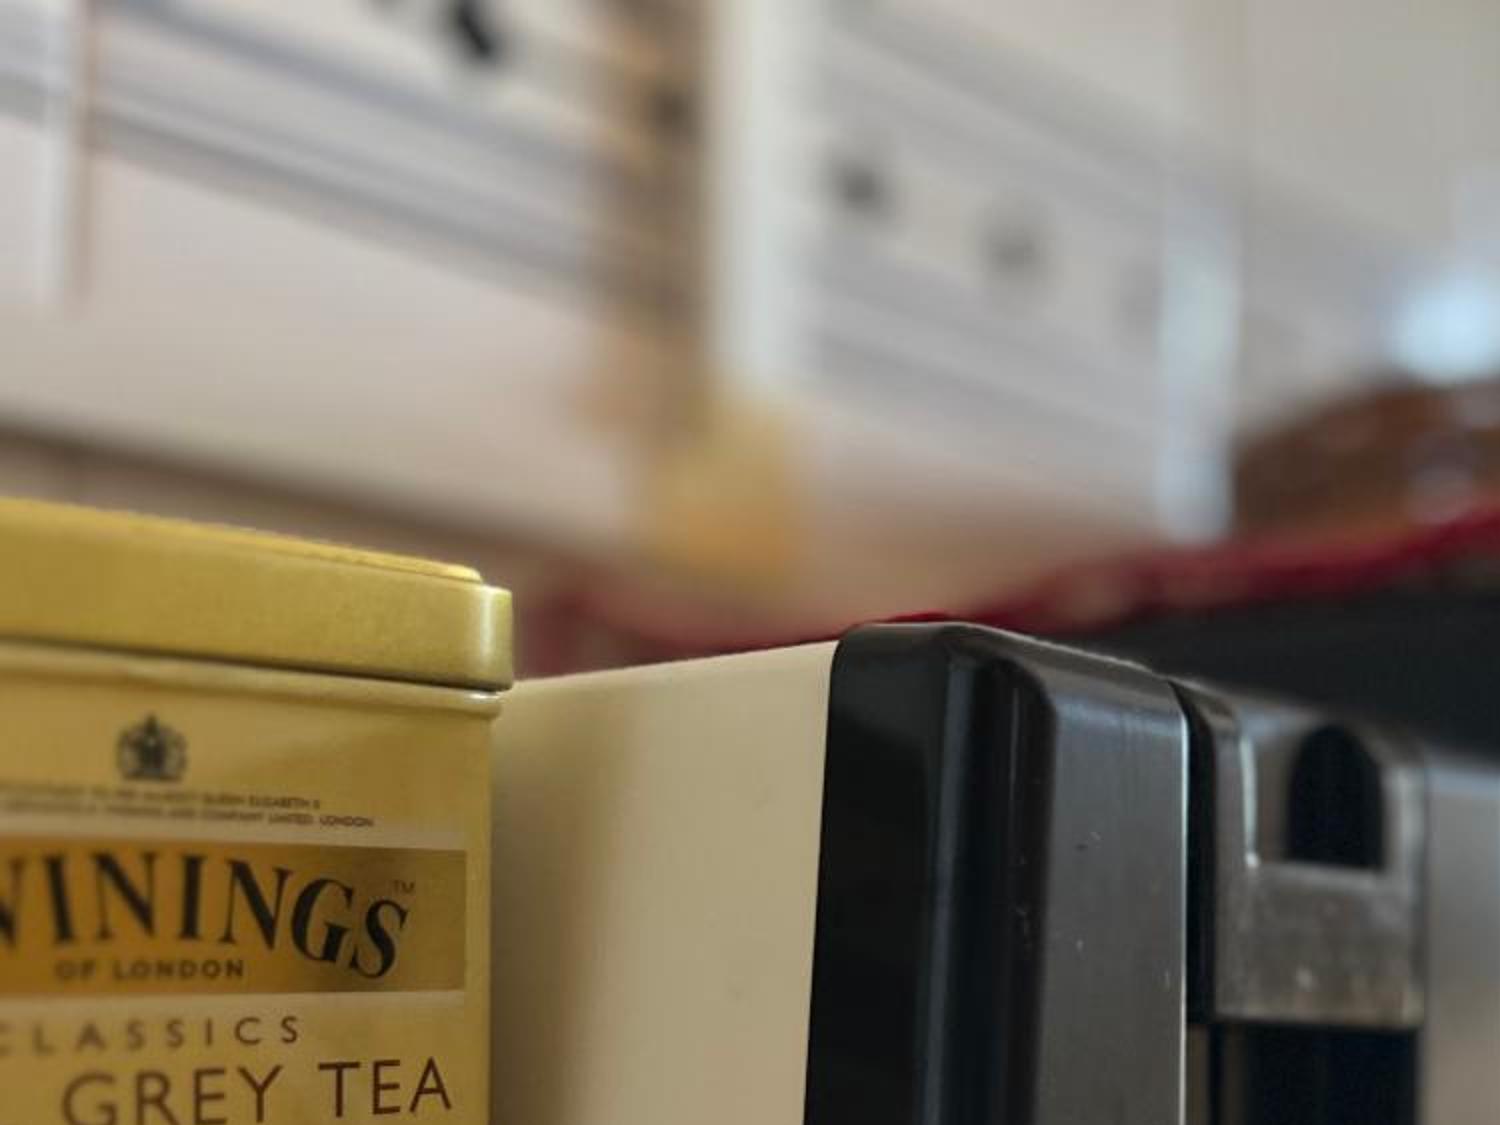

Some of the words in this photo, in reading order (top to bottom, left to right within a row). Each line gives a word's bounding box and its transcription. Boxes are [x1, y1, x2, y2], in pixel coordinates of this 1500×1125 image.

[319, 814, 374, 828] LONDON
[55, 958, 96, 982] OF
[113, 958, 246, 983] LONDON
[317, 1056, 453, 1118] TEA
